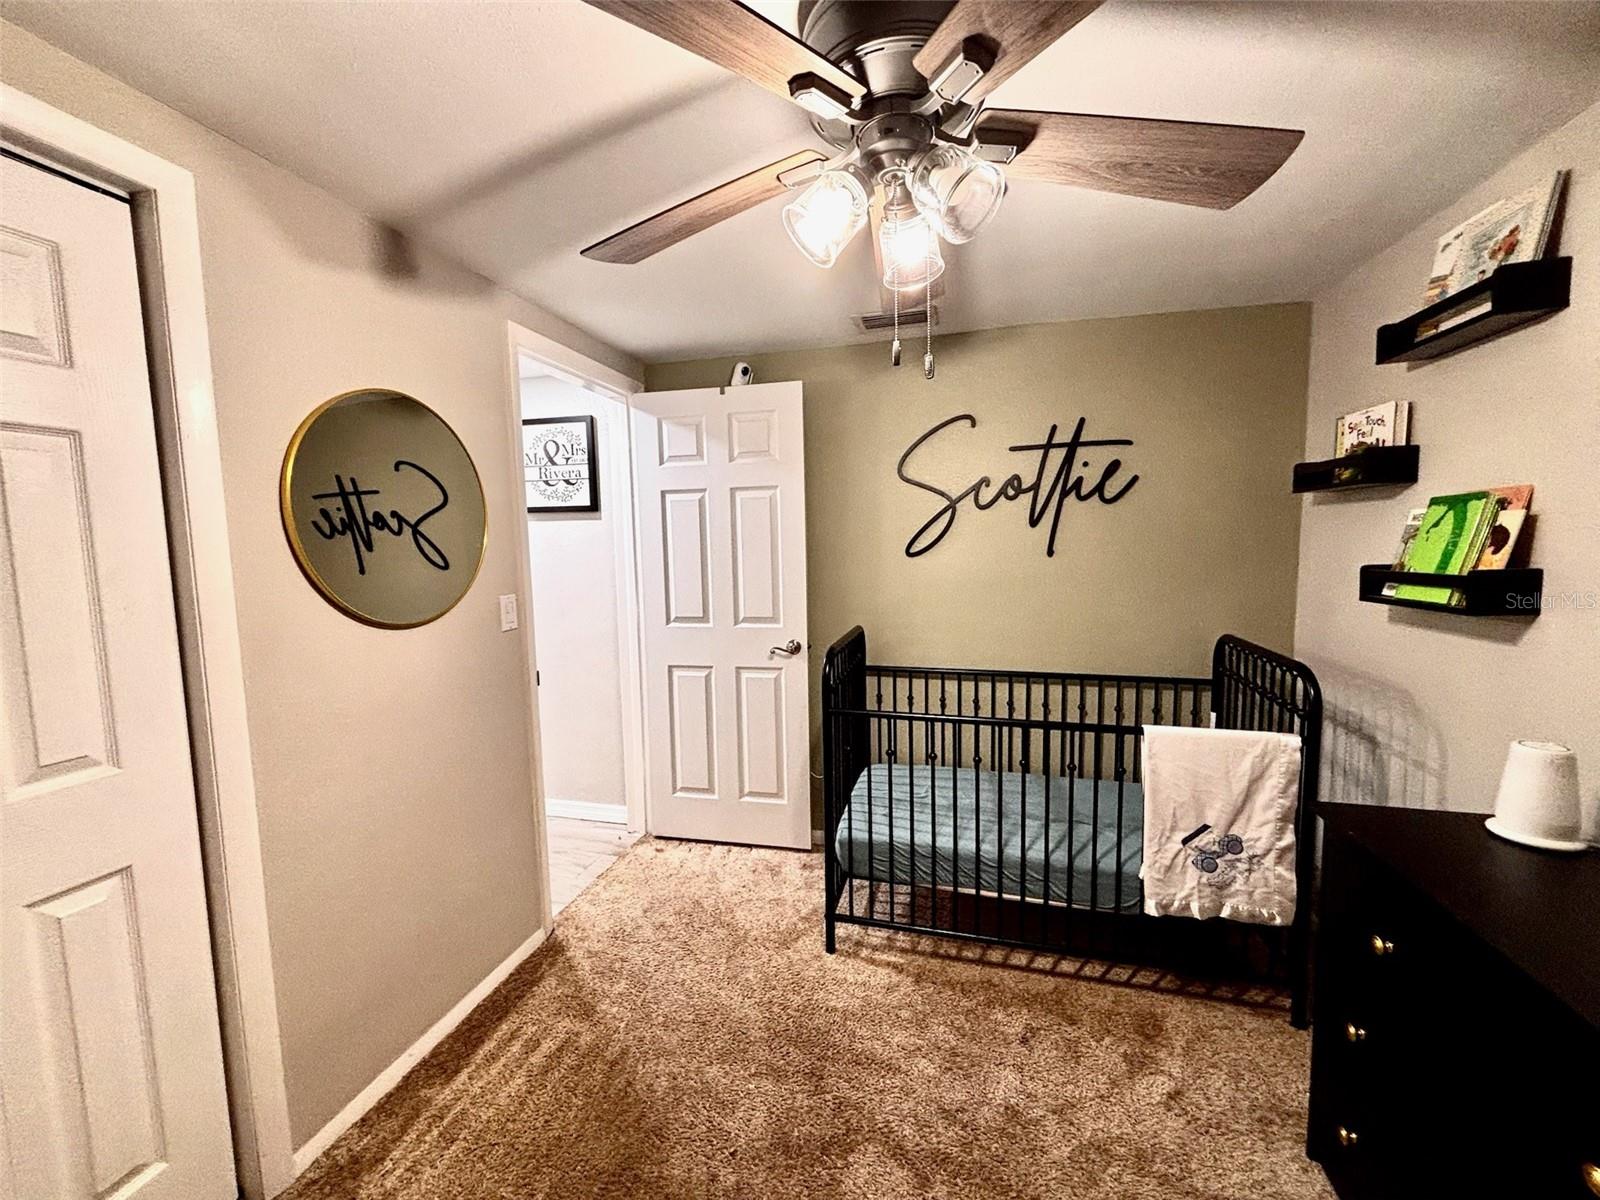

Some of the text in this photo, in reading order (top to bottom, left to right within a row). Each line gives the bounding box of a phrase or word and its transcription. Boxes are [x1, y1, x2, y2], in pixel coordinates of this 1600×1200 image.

[525, 452, 545, 466] Mr
[562, 443, 587, 457] Mrs
[538, 466, 583, 480] Rivera
[897, 413, 1140, 559] Scottie
